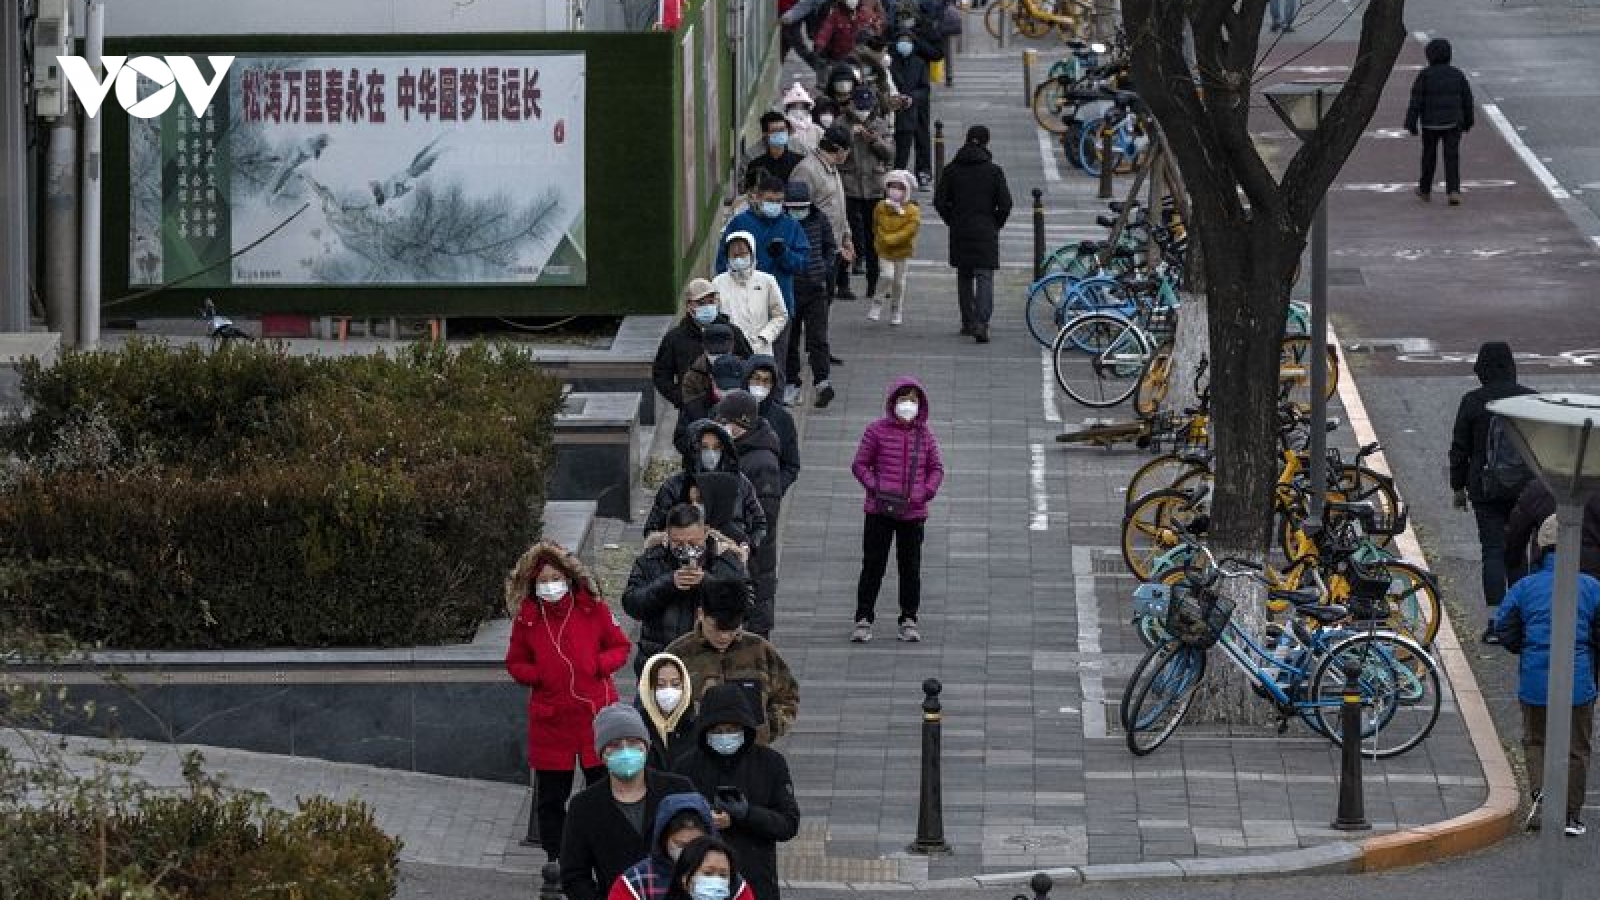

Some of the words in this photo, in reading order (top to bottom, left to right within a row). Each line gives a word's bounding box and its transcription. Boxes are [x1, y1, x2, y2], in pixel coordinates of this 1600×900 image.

[243, 68, 385, 123] 松涛万里春永在
